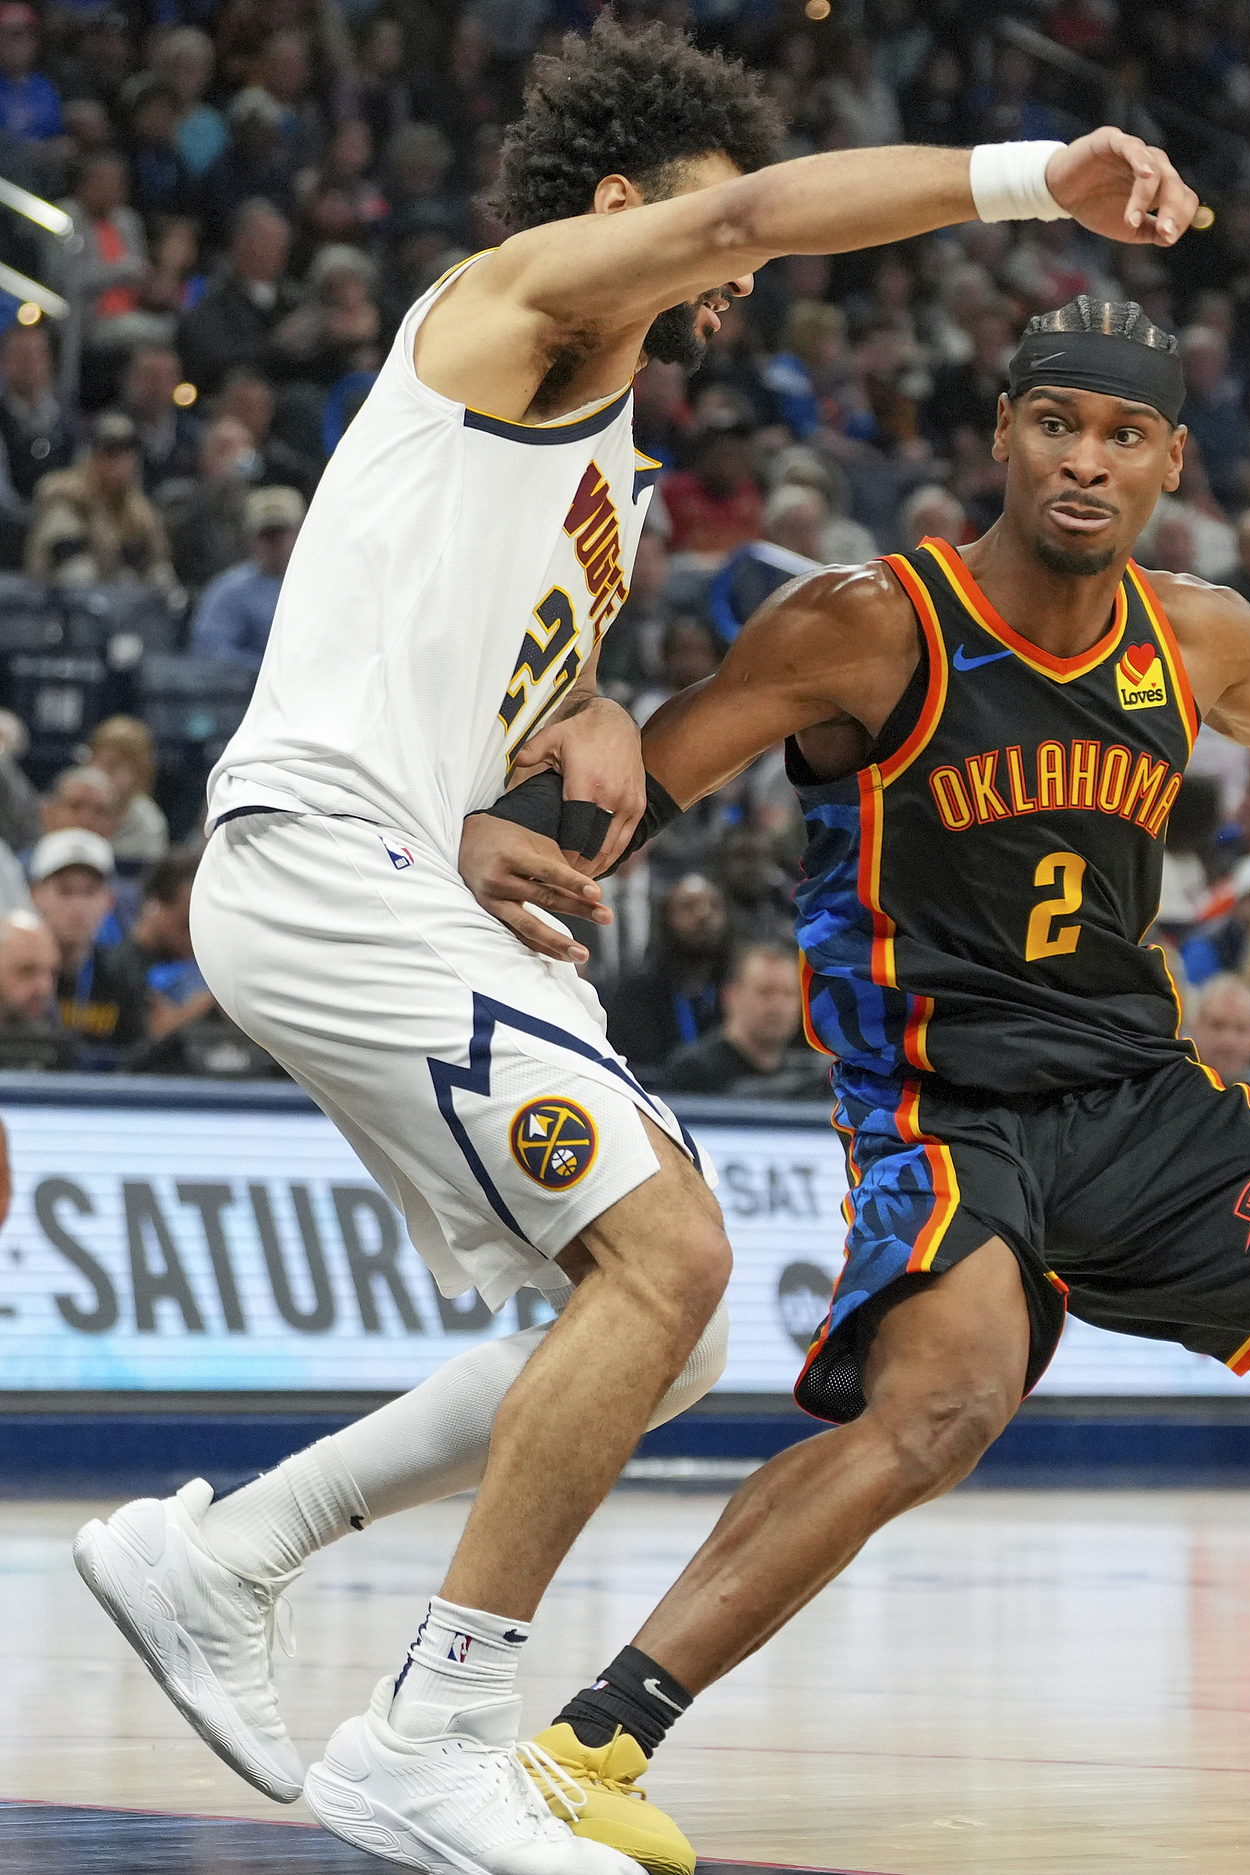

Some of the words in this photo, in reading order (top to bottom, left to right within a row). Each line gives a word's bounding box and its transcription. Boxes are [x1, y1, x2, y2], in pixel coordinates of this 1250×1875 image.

[928, 738, 1183, 840] OKLAHOMA
[1025, 851, 1087, 962] 2
[34, 1177, 560, 1336] SATUR
